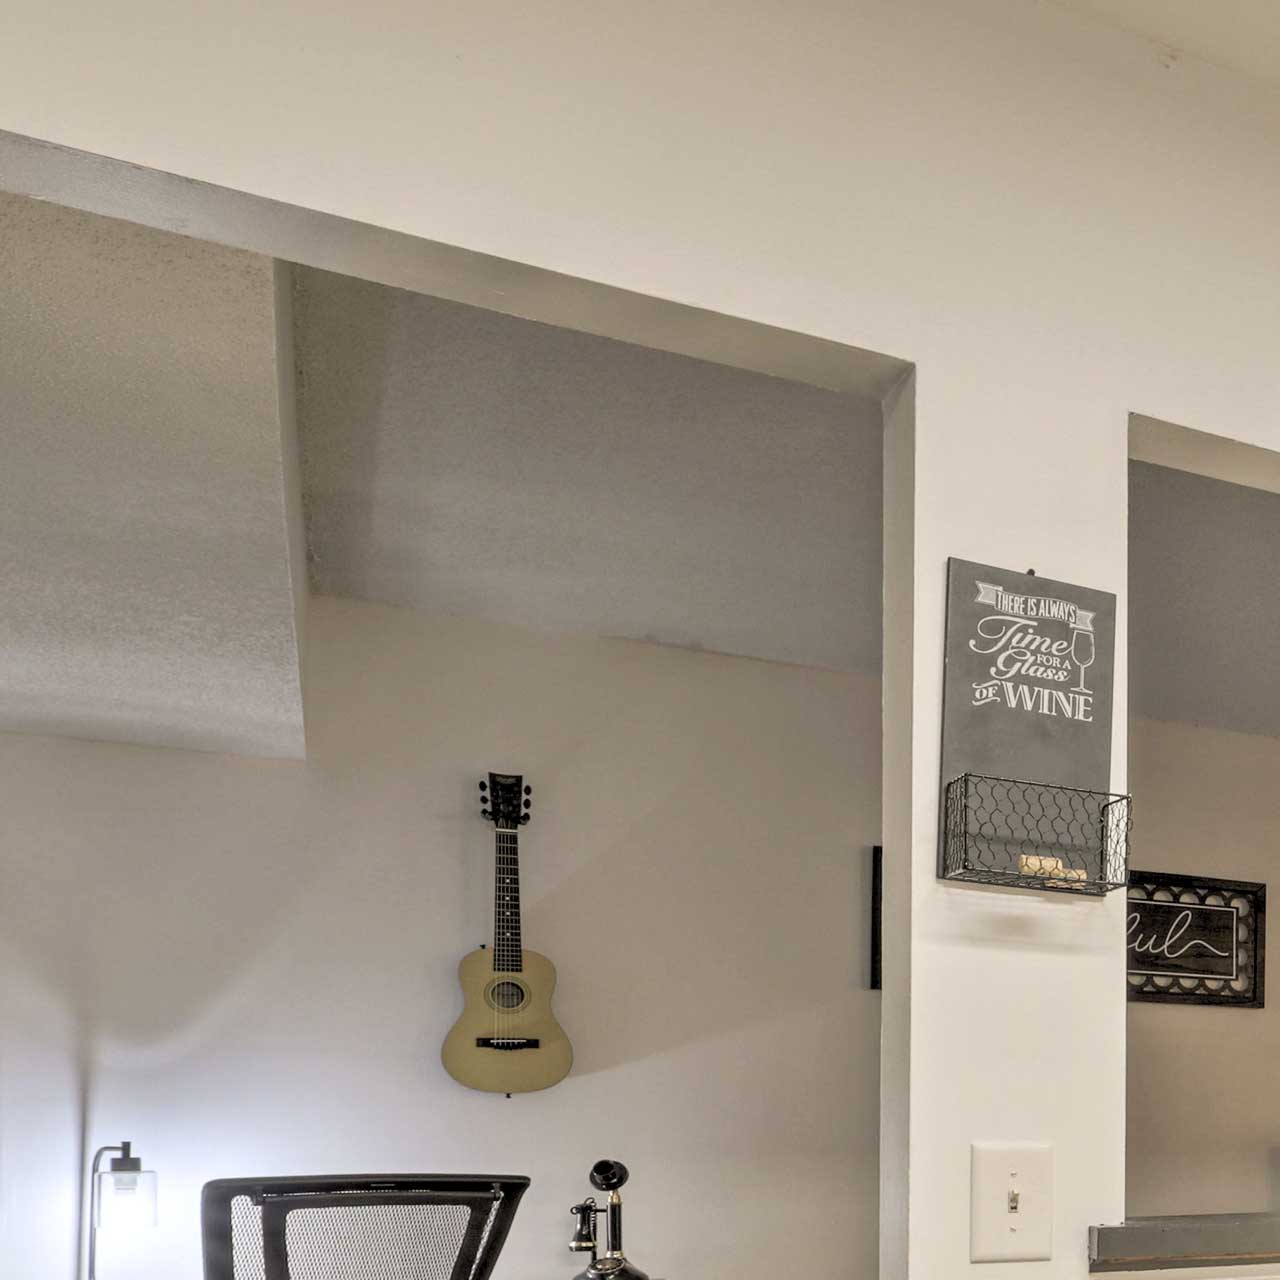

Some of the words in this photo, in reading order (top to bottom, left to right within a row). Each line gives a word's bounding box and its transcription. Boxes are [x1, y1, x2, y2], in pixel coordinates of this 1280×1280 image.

[997, 591, 1026, 615] THERE
[1027, 597, 1037, 616] IS
[1038, 598, 1076, 623] ALWAYS
[969, 615, 1072, 655] Time
[990, 648, 1071, 682] Glass
[1036, 653, 1061, 668] FOR
[1062, 660, 1072, 670] A
[974, 685, 999, 700] OF
[1001, 681, 1093, 722] WINE
